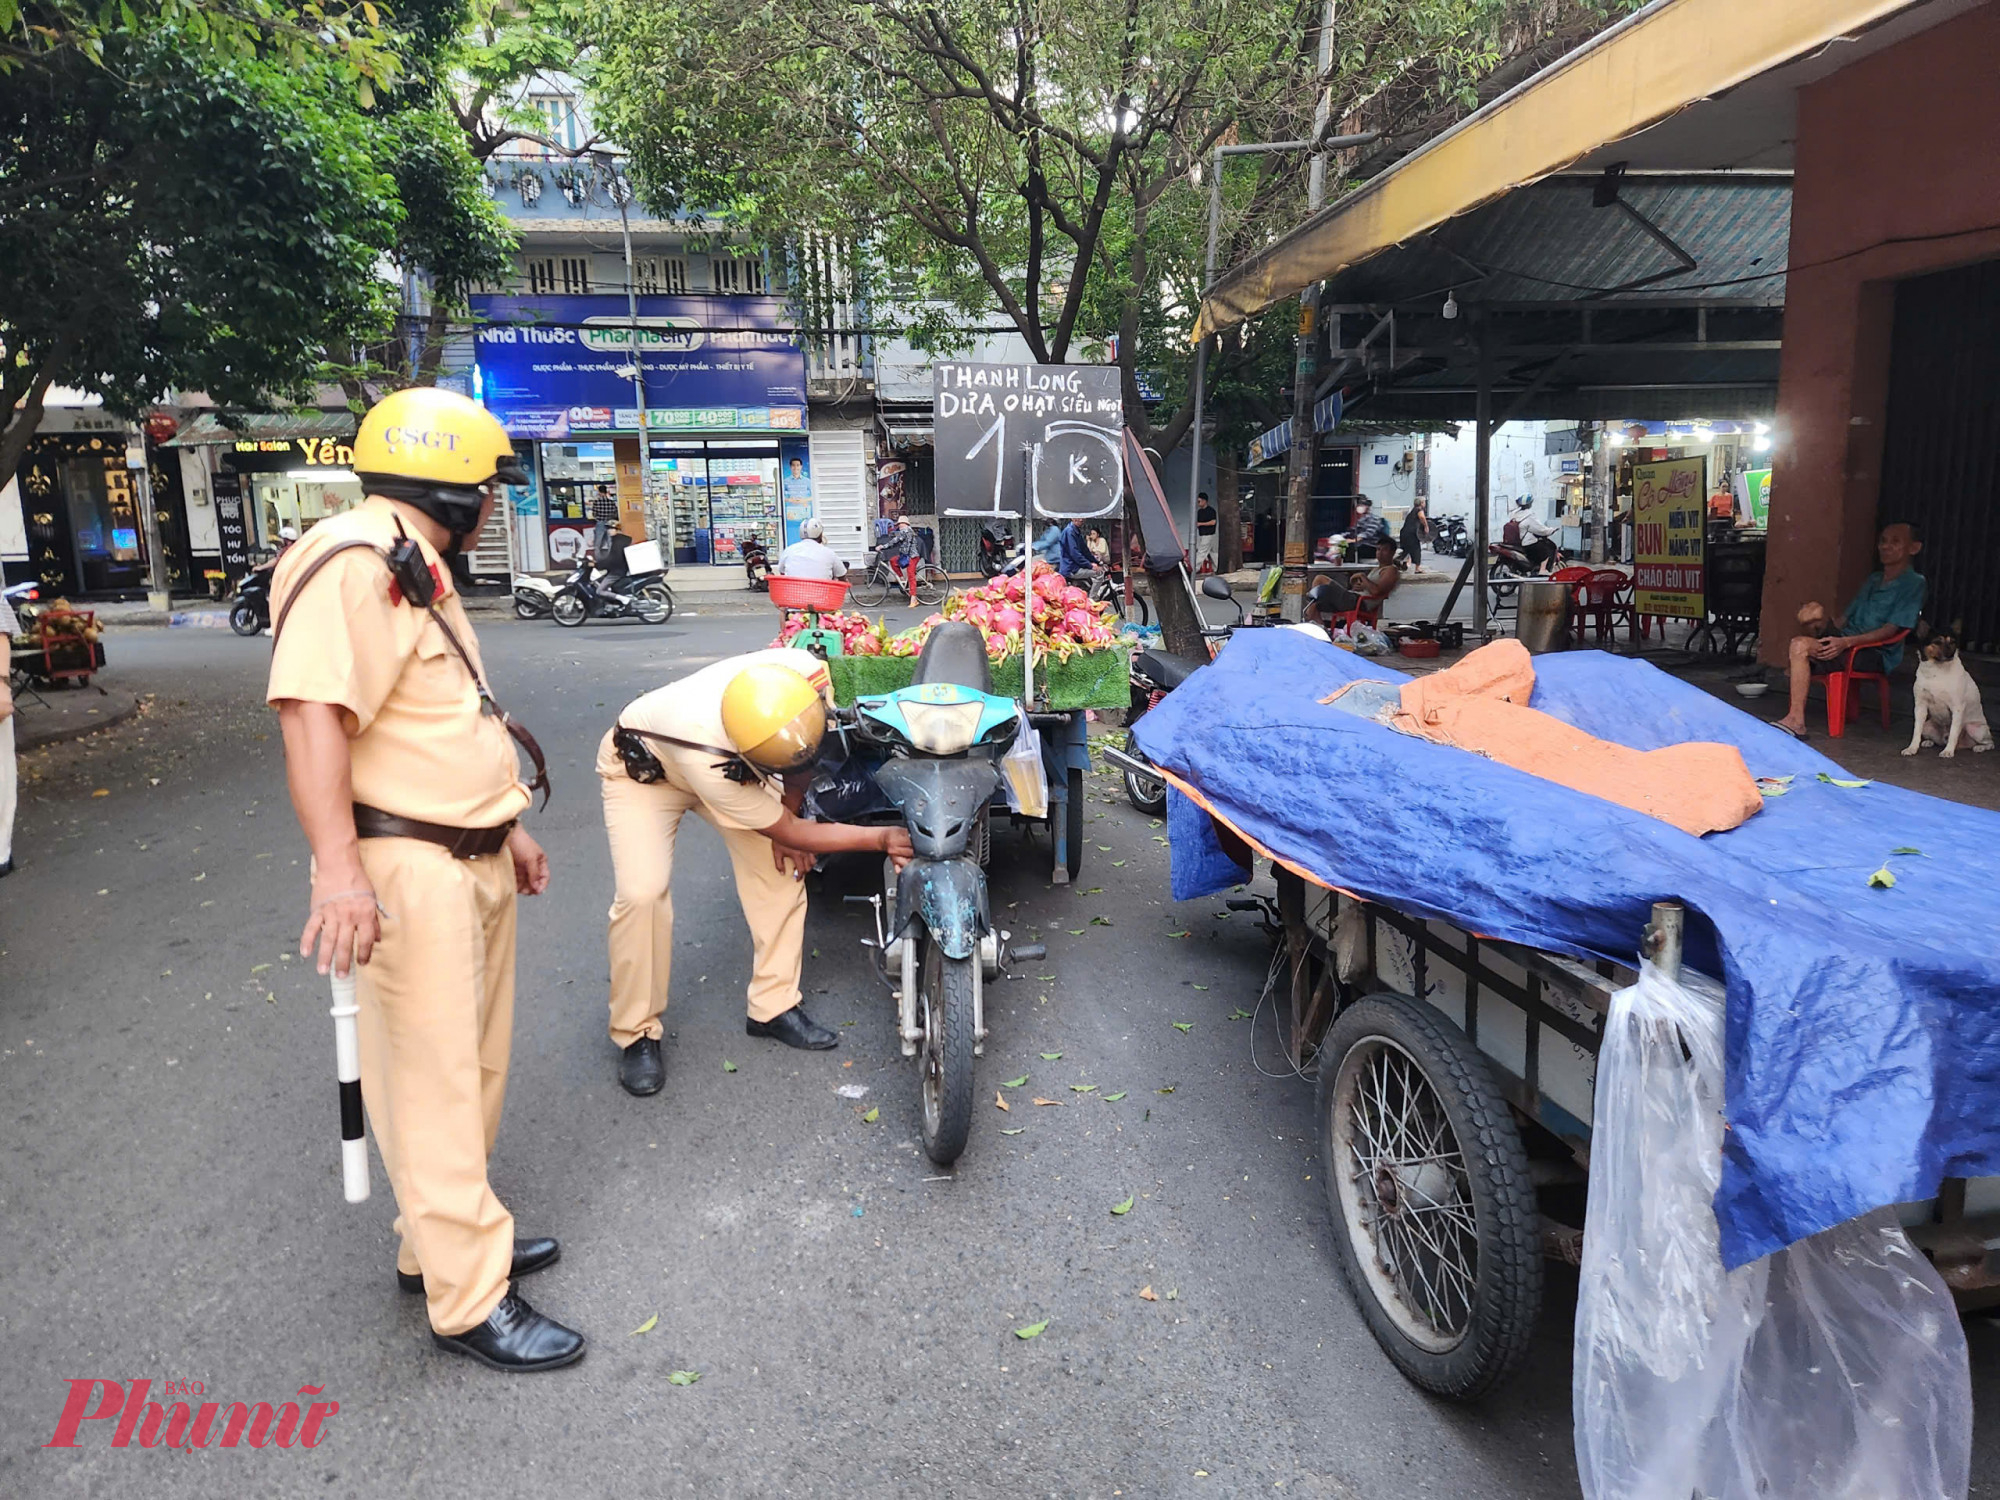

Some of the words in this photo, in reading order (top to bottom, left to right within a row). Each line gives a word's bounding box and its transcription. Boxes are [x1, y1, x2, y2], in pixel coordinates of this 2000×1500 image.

[519, 326, 576, 344] Thuốc
[939, 365, 1019, 389] THANH
[1025, 366, 1082, 394] LONG
[1022, 394, 1056, 418] HẠT
[1062, 392, 1092, 413] SIÊU
[1097, 399, 1123, 419] NGỌT
[259, 440, 291, 452] Salon
[385, 426, 461, 451] CSGT
[222, 524, 242, 534] TÓC
[1637, 515, 1662, 555] BÚN
[1637, 565, 1662, 587] CHÁO
[1665, 563, 1682, 588] GỎI
[1685, 569, 1701, 593] VỊT
